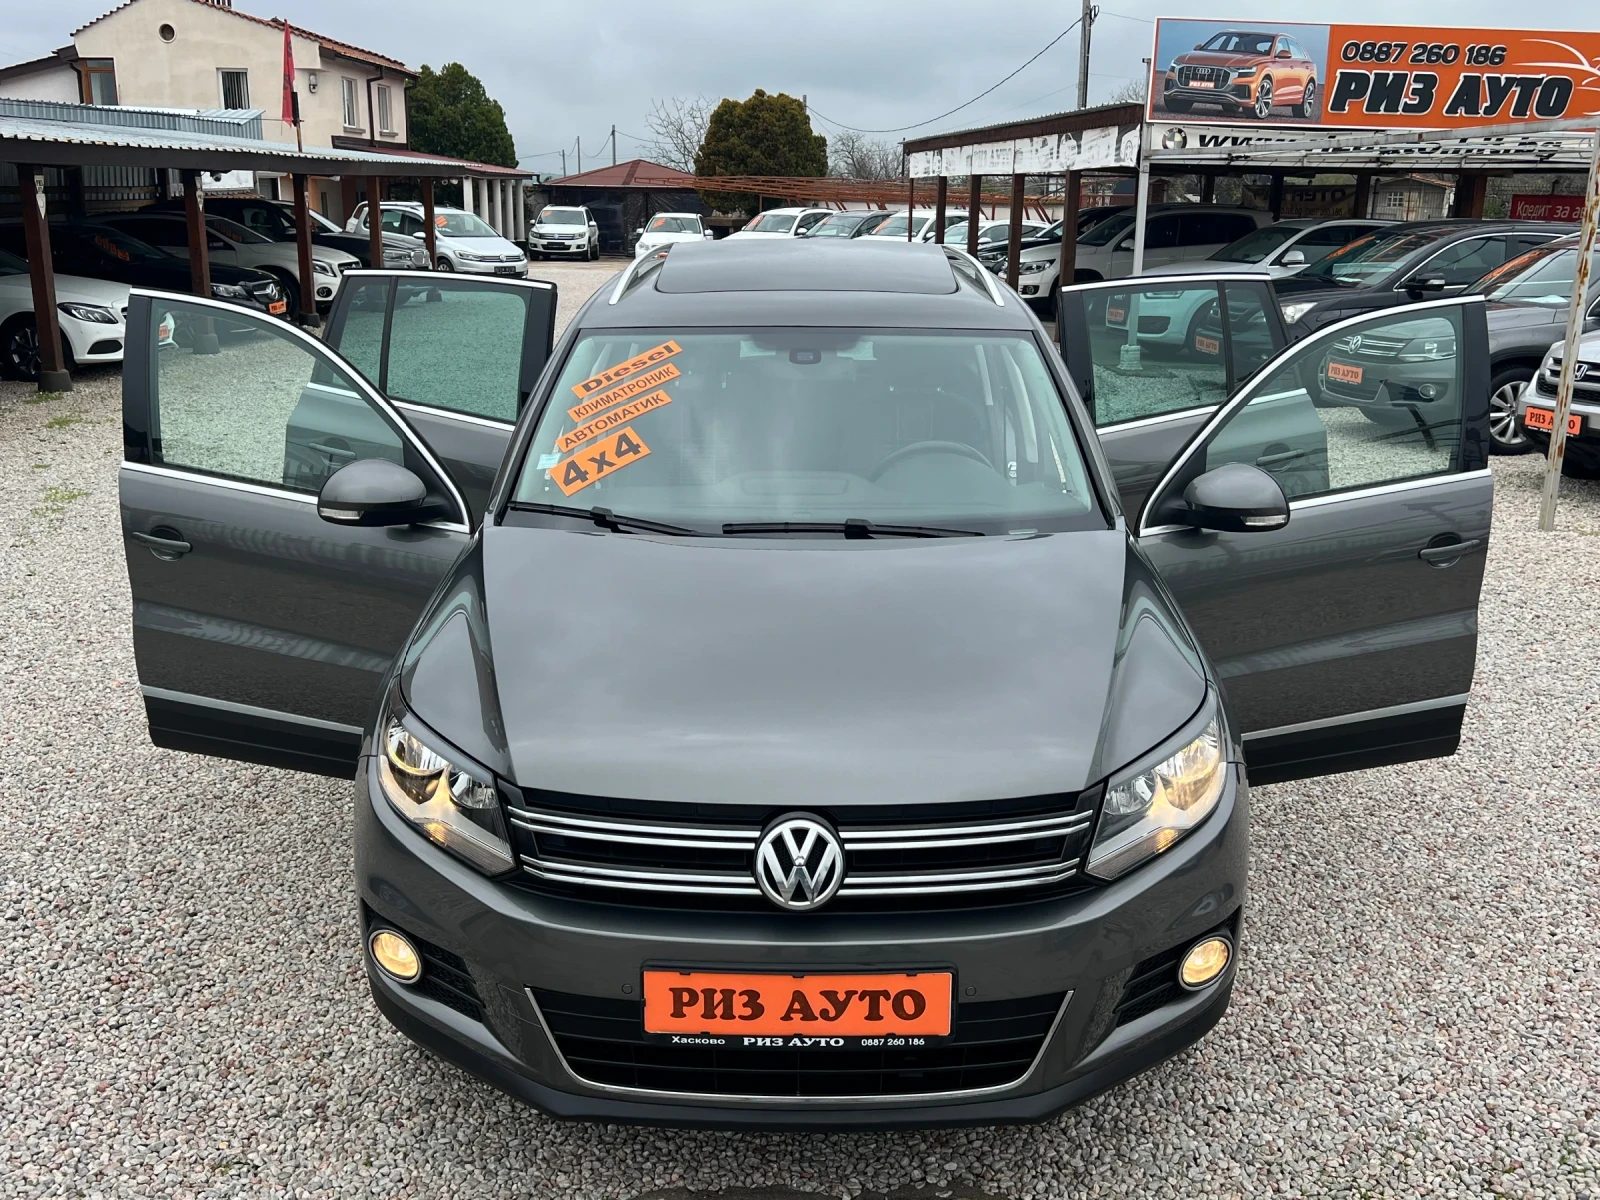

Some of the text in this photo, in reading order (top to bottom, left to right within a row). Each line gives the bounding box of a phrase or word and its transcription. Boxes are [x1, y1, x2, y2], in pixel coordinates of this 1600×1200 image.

[1341, 40, 1508, 66] 0887 260 186
[1328, 69, 1576, 119] РИЗ АУТО
[1516, 201, 1552, 219] Кредит
[1554, 206, 1570, 218] за
[581, 344, 675, 393] Diesel
[1341, 369, 1359, 379] АУТО
[573, 366, 674, 418] КЛИМАТРОНИК
[564, 393, 664, 448] АВТОМАТИК
[1530, 412, 1576, 430] РИЗ АО
[669, 987, 927, 1022] РИЗ АУТО
[672, 1035, 926, 1047] Хасково РИЗ АУТО 0887 260 186
